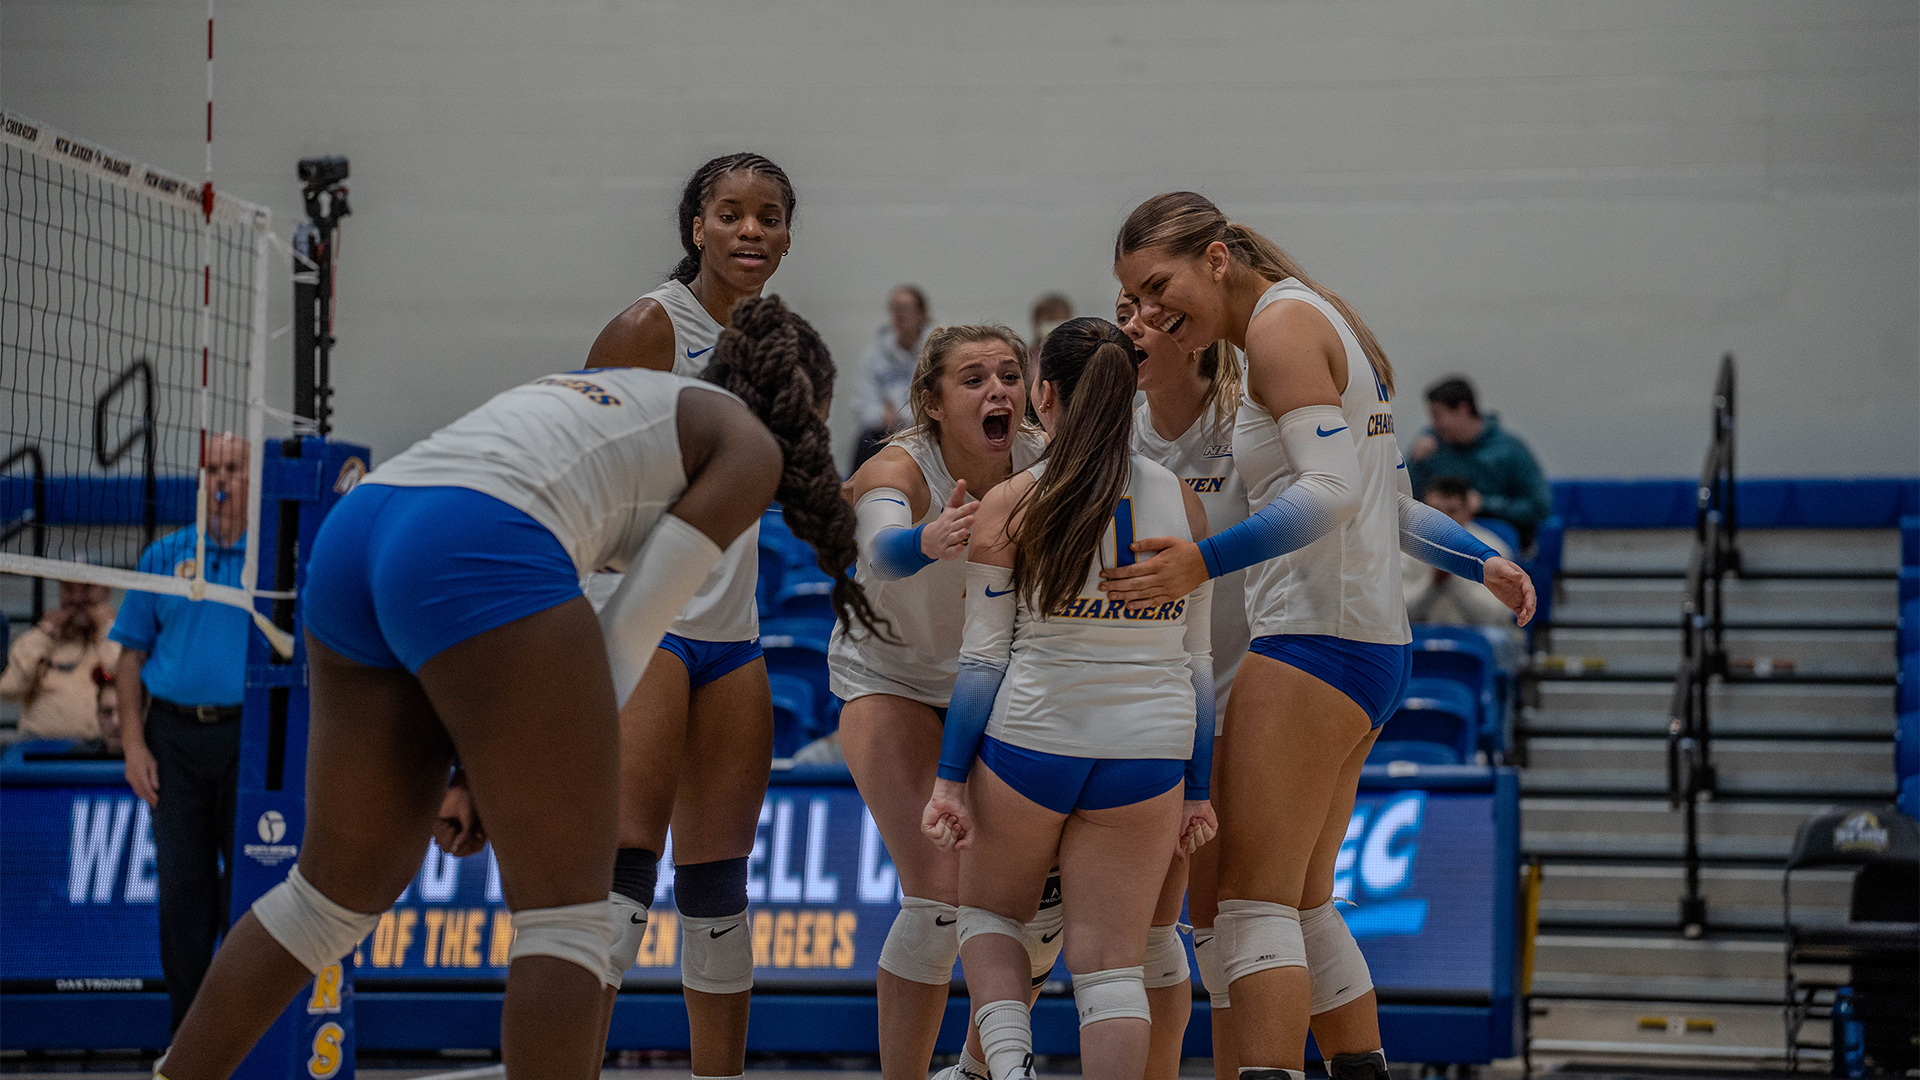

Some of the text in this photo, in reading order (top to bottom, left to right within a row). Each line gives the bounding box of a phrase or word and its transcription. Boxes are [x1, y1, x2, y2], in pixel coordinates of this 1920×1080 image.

[1050, 597, 1186, 621] HARGERS
[424, 908, 487, 968] THE
[56, 978, 144, 992] DAKTRONICS
